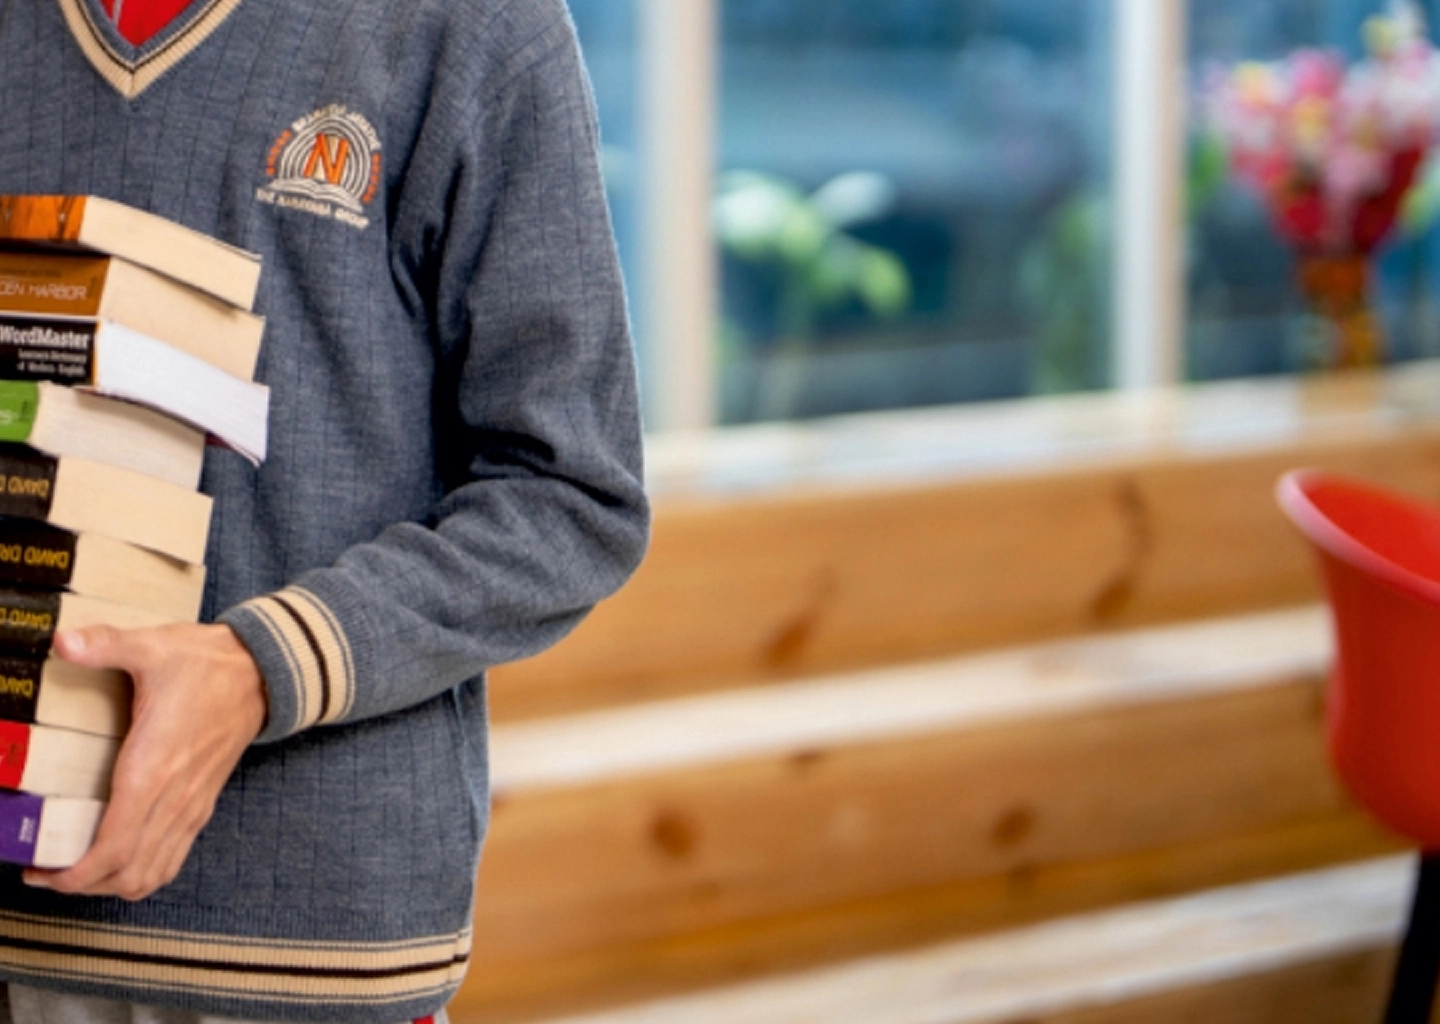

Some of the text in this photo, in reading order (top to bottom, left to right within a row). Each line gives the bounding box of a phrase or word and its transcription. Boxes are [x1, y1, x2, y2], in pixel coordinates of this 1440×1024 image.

[303, 132, 350, 185] N
[28, 282, 88, 301] HARBOR
[8, 478, 50, 498] DAVID
[24, 548, 70, 569] DAVID
[8, 611, 52, 631] DAVID
